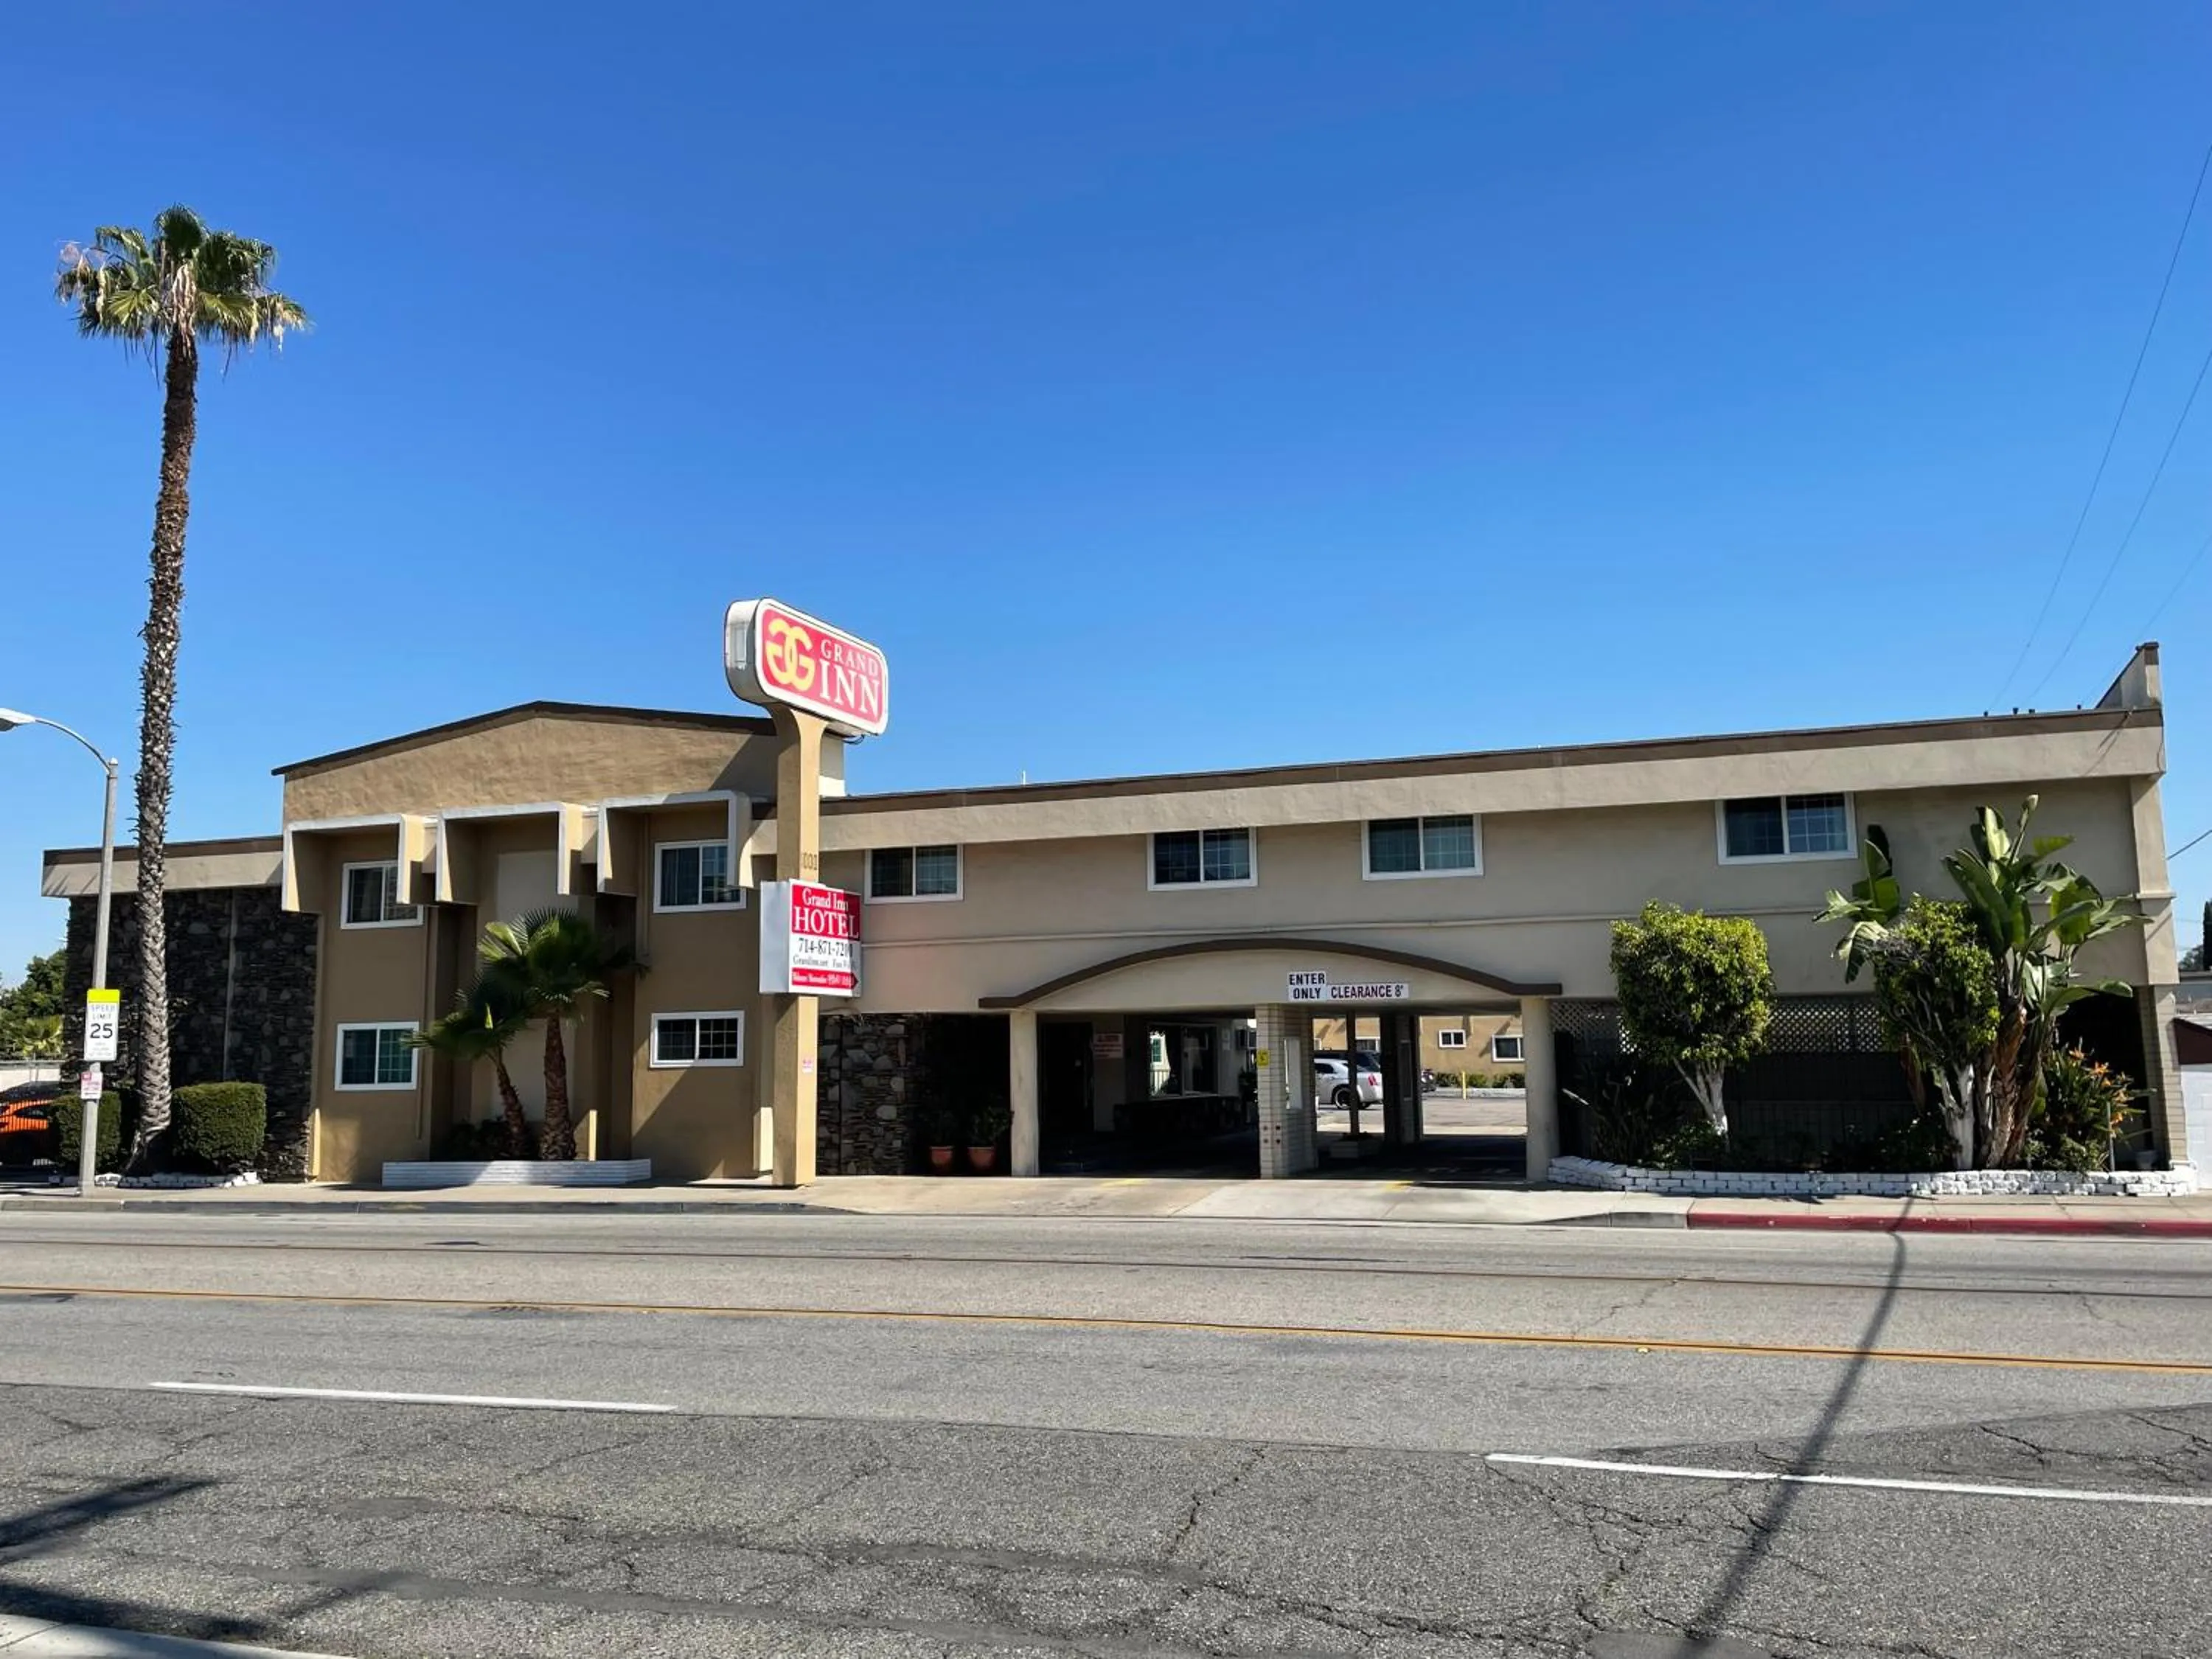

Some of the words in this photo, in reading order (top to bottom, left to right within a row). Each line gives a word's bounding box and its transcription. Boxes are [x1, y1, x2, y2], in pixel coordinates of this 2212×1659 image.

[821, 639, 879, 677] GRAND
[818, 658, 880, 717] INN
[802, 887, 831, 908] Grand
[793, 906, 859, 939] HOTEL
[1289, 973, 1325, 985] ENTER
[1293, 987, 1321, 999] ONLY
[1331, 985, 1392, 998] CLEARANCE
[91, 1004, 116, 1012] SPEED
[89, 1023, 113, 1039] 25
